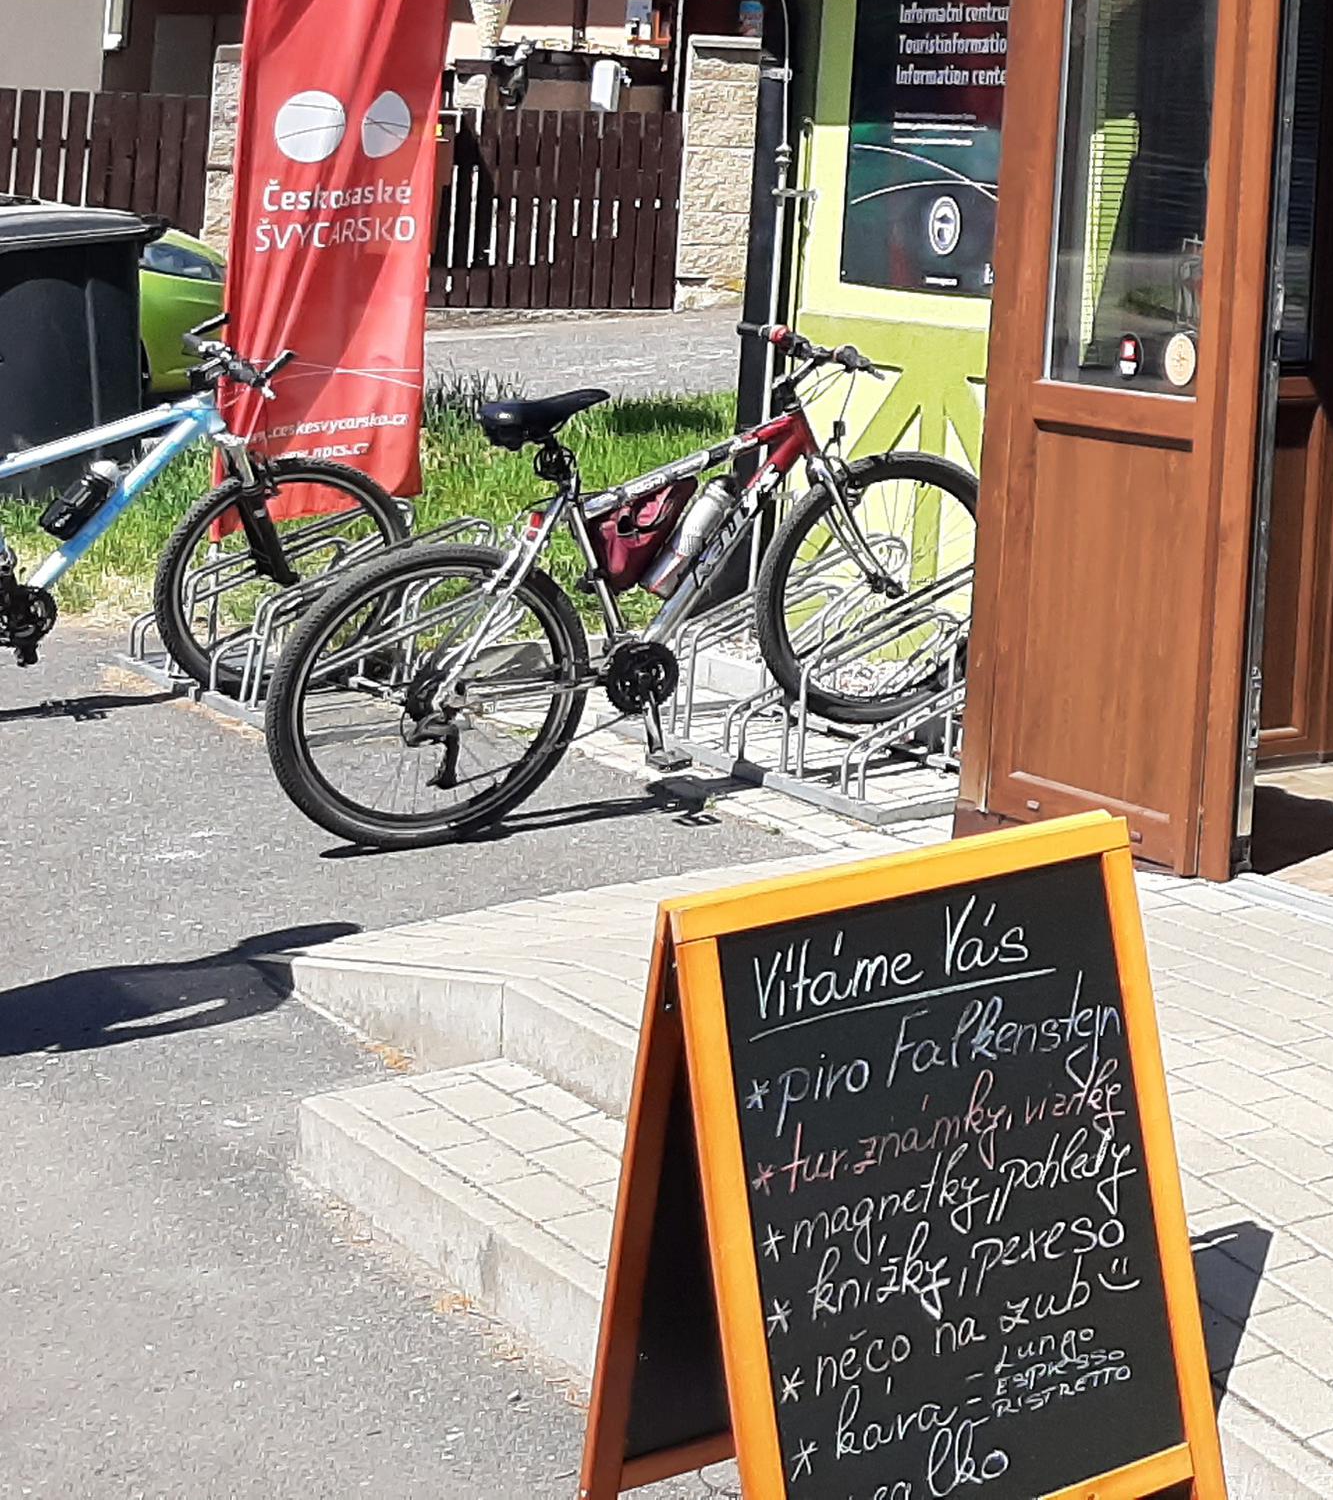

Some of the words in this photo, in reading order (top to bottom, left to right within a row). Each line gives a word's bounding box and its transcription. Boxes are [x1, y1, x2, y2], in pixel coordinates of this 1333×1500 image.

[898, 31, 1009, 55] Touristinformatio
[895, 63, 969, 86] Information
[972, 65, 1008, 86] cente
[753, 930, 924, 1019] Vítáme
[944, 894, 1029, 976] Vás
[934, 1316, 987, 1355] na
[1000, 1255, 1091, 1334] zub
